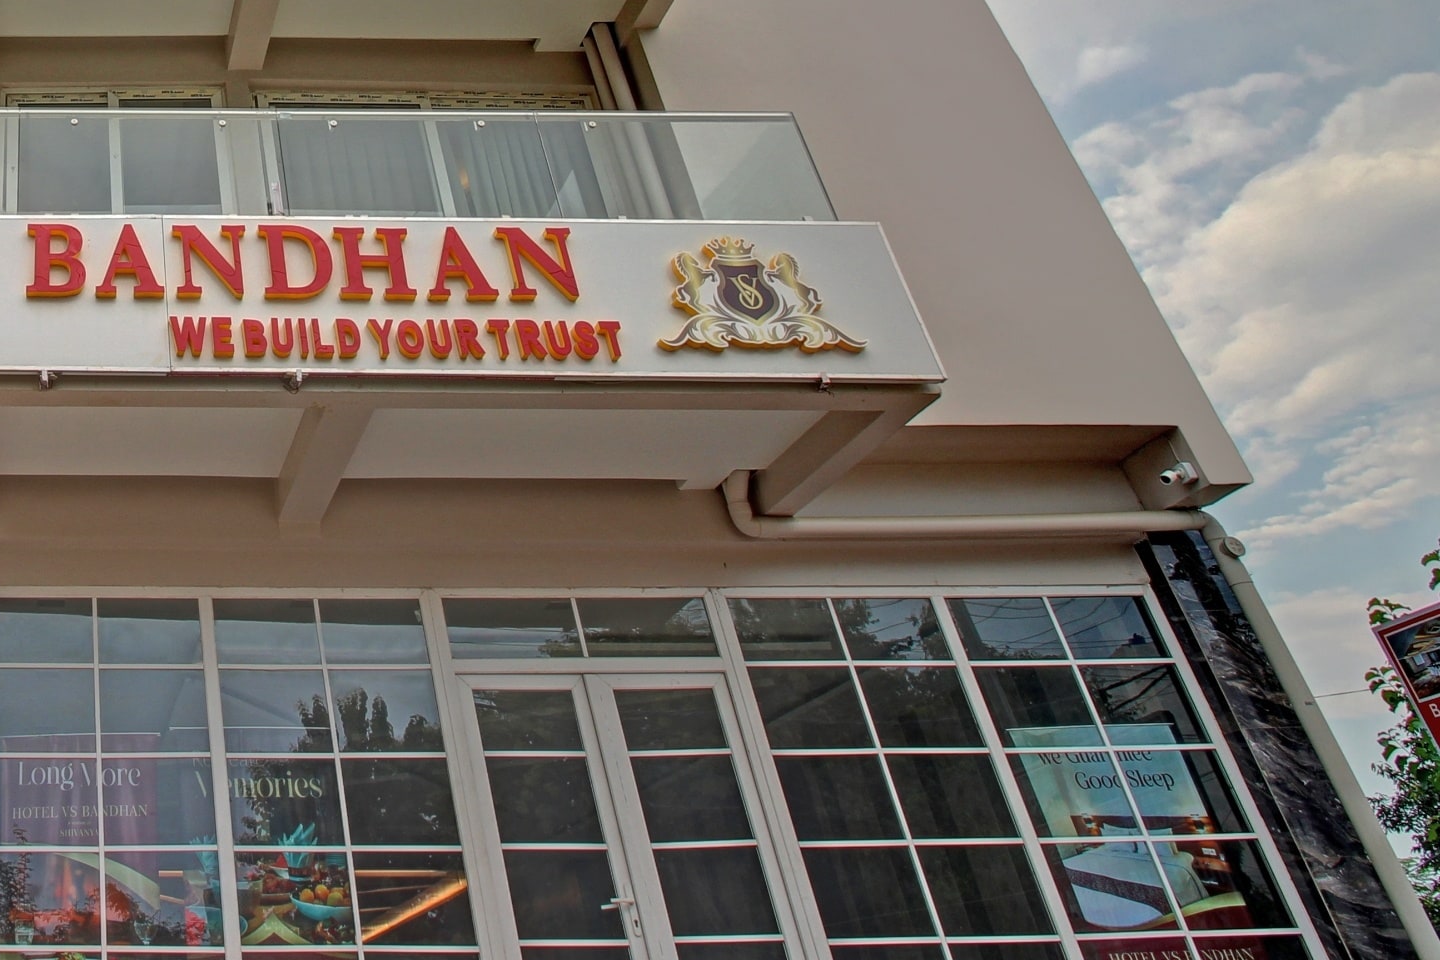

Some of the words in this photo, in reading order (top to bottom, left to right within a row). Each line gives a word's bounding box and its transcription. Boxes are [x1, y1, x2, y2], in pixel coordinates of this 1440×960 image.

[26, 224, 579, 304] BANDHAN
[170, 317, 235, 359] WE
[242, 318, 361, 360] BUILD
[367, 319, 486, 360] YOUR
[485, 319, 621, 362] TRUST
[18, 761, 75, 790] Long
[1124, 769, 1175, 790] Sleep
[12, 806, 59, 820] HOTEL
[62, 805, 78, 818] VS
